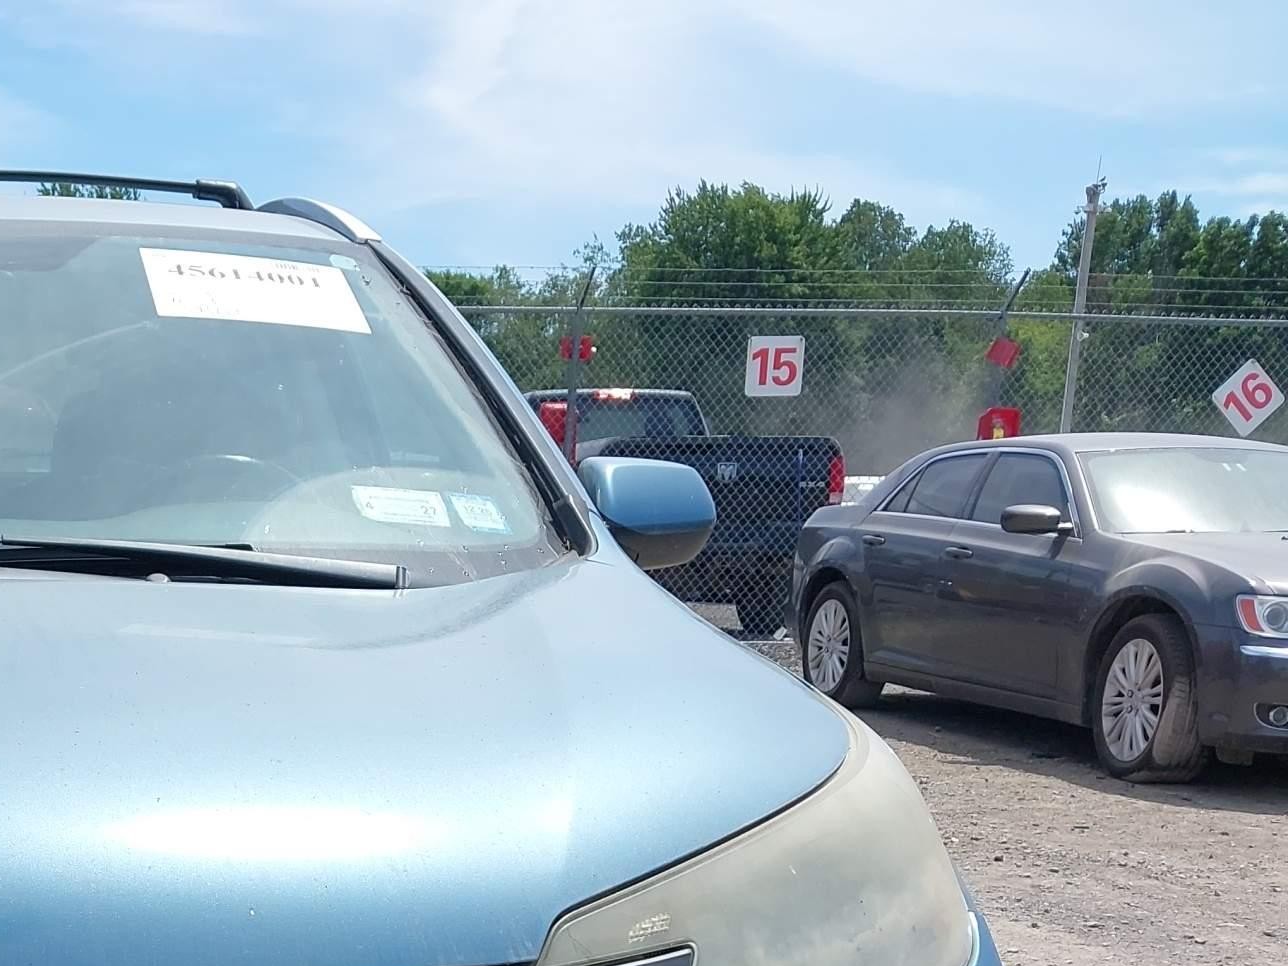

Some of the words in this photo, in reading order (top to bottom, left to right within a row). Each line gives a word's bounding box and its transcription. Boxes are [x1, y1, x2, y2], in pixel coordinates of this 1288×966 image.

[168, 263, 321, 289] 45614001
[752, 347, 798, 386] 15
[1223, 372, 1273, 423] 16
